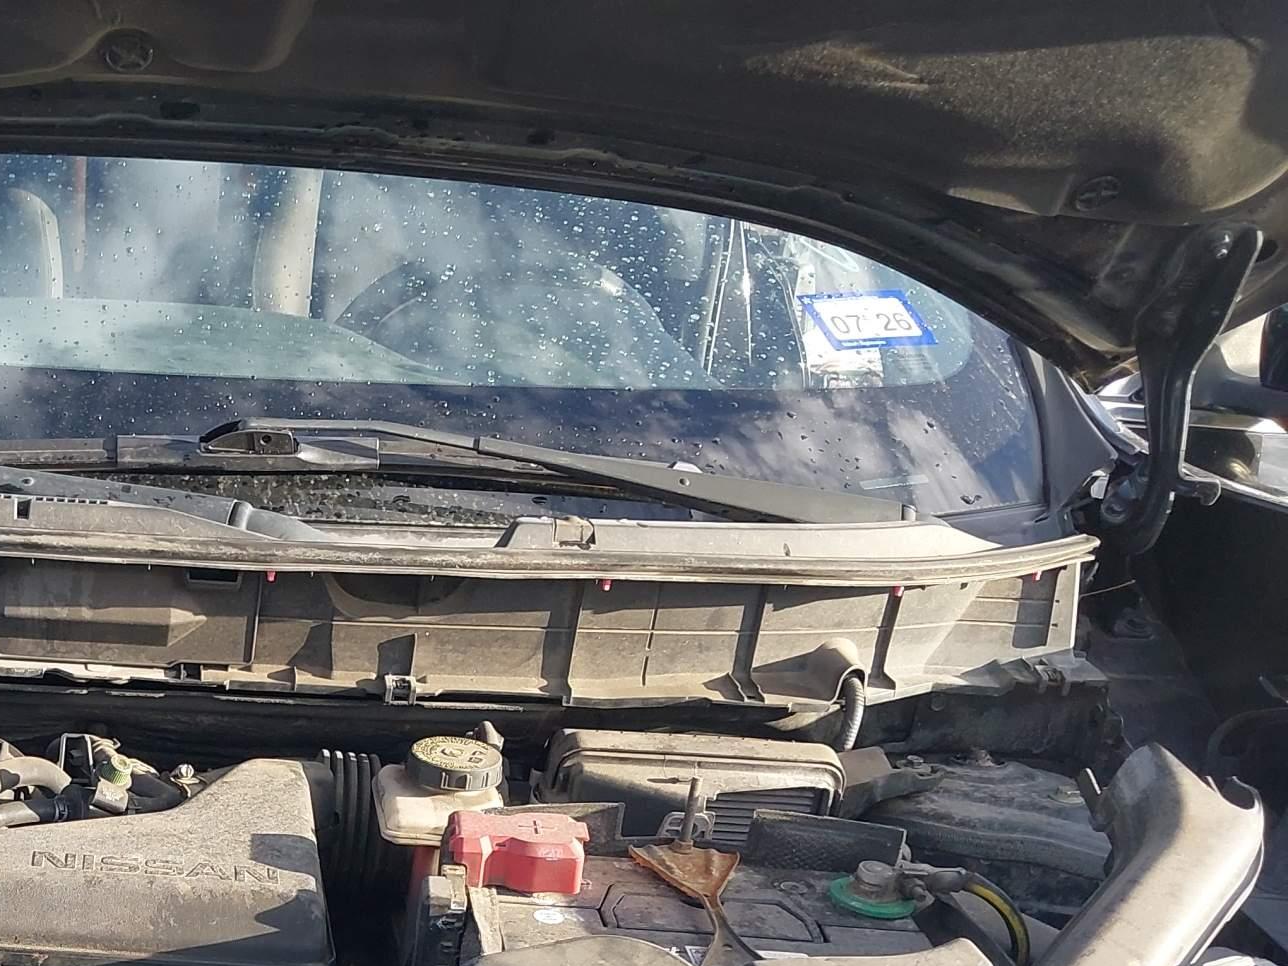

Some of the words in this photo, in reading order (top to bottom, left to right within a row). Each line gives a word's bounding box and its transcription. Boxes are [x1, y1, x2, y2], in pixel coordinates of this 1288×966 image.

[830, 314, 862, 334] 07
[876, 312, 913, 331] 26
[30, 850, 281, 885] NISSAN
